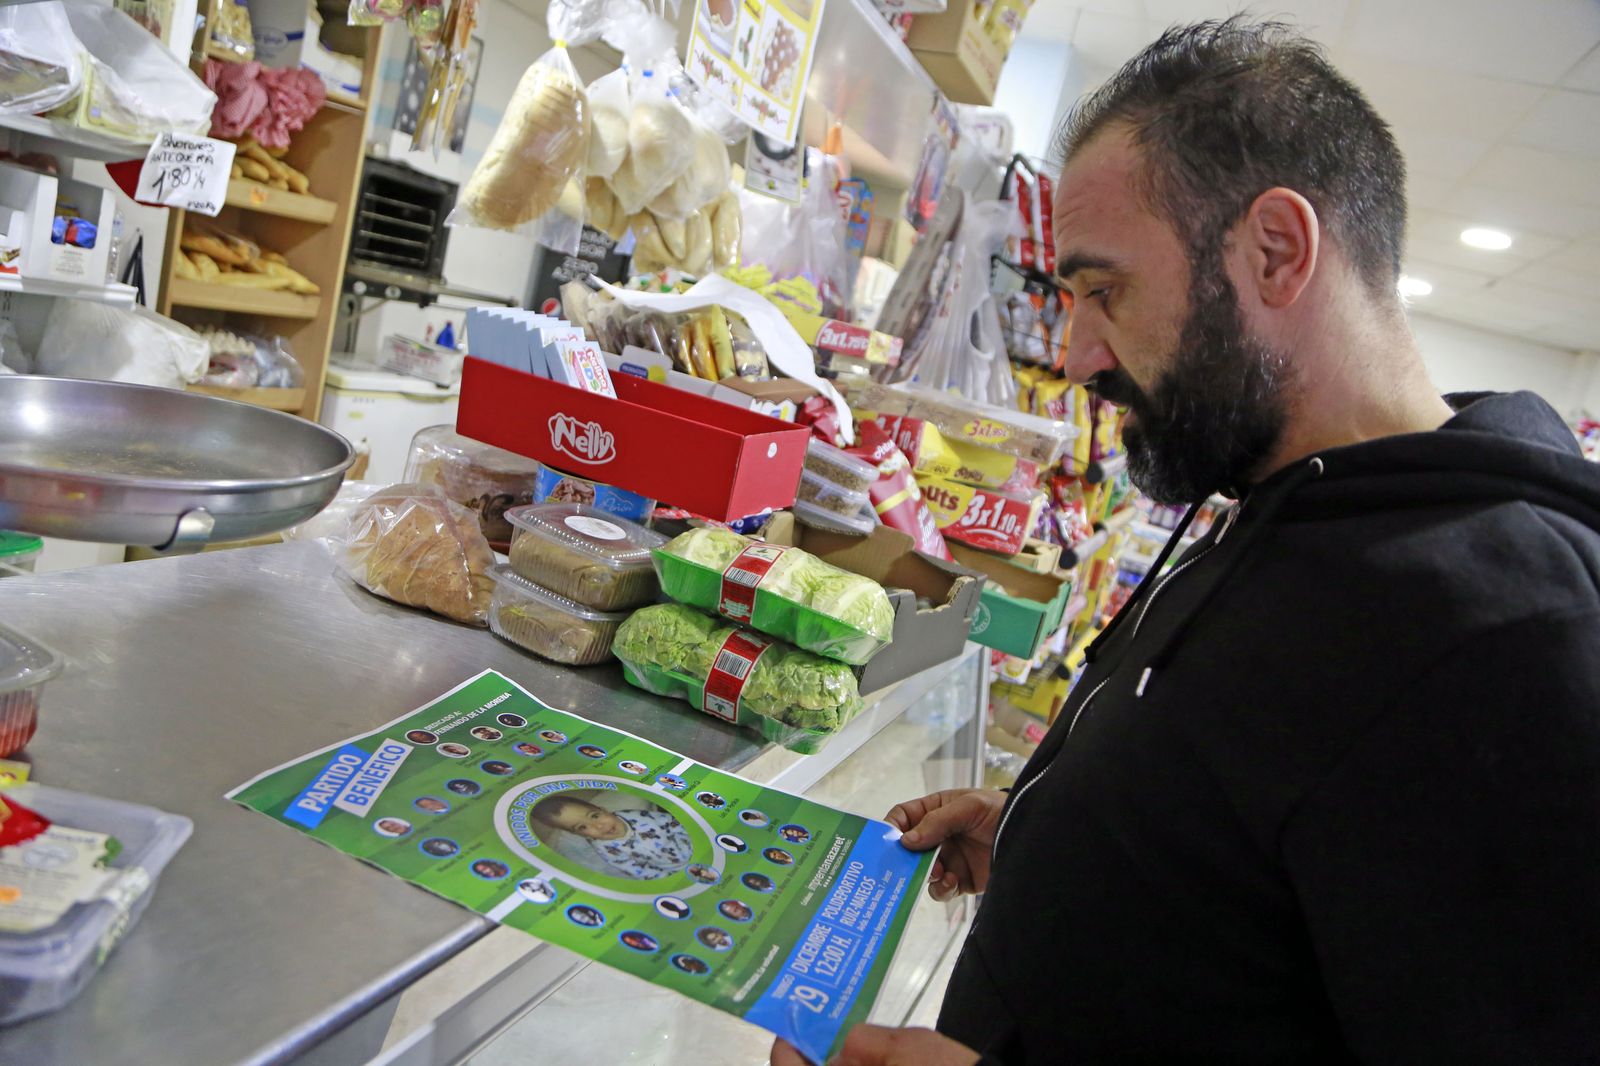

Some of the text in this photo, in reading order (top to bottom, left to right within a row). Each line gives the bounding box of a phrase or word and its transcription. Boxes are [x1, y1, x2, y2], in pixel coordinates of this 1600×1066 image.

[553, 416, 613, 460] Nelly
[433, 716, 470, 735] FERNANDO
[481, 692, 512, 708] MORENA
[297, 754, 362, 813] PARTIDO
[344, 743, 406, 807] BENÉFICO
[511, 779, 618, 848] UNIDOS POR UNA VIDA
[822, 861, 864, 920] POLIDEPORTIVO
[791, 922, 832, 974] DICIEMBRE
[814, 945, 846, 976] 12:00
[831, 935, 852, 950] H.
